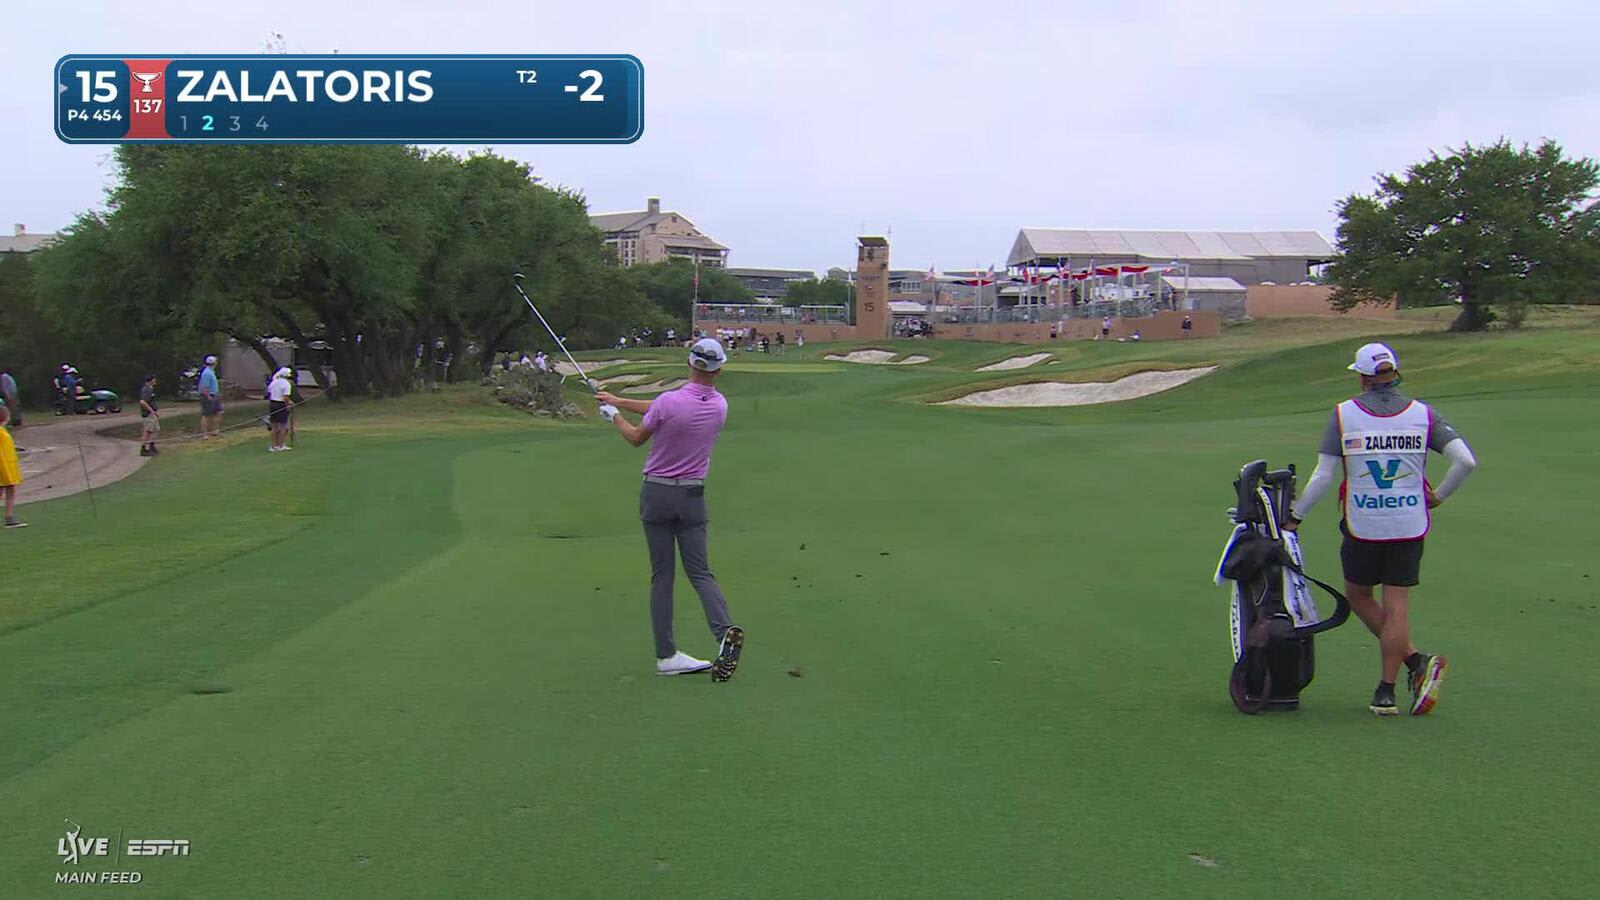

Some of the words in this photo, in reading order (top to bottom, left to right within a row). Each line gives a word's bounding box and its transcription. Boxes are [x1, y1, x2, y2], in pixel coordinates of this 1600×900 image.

[864, 302, 874, 312] 15
[1365, 436, 1422, 450] ZALATORIS
[1353, 494, 1418, 509] Valero
